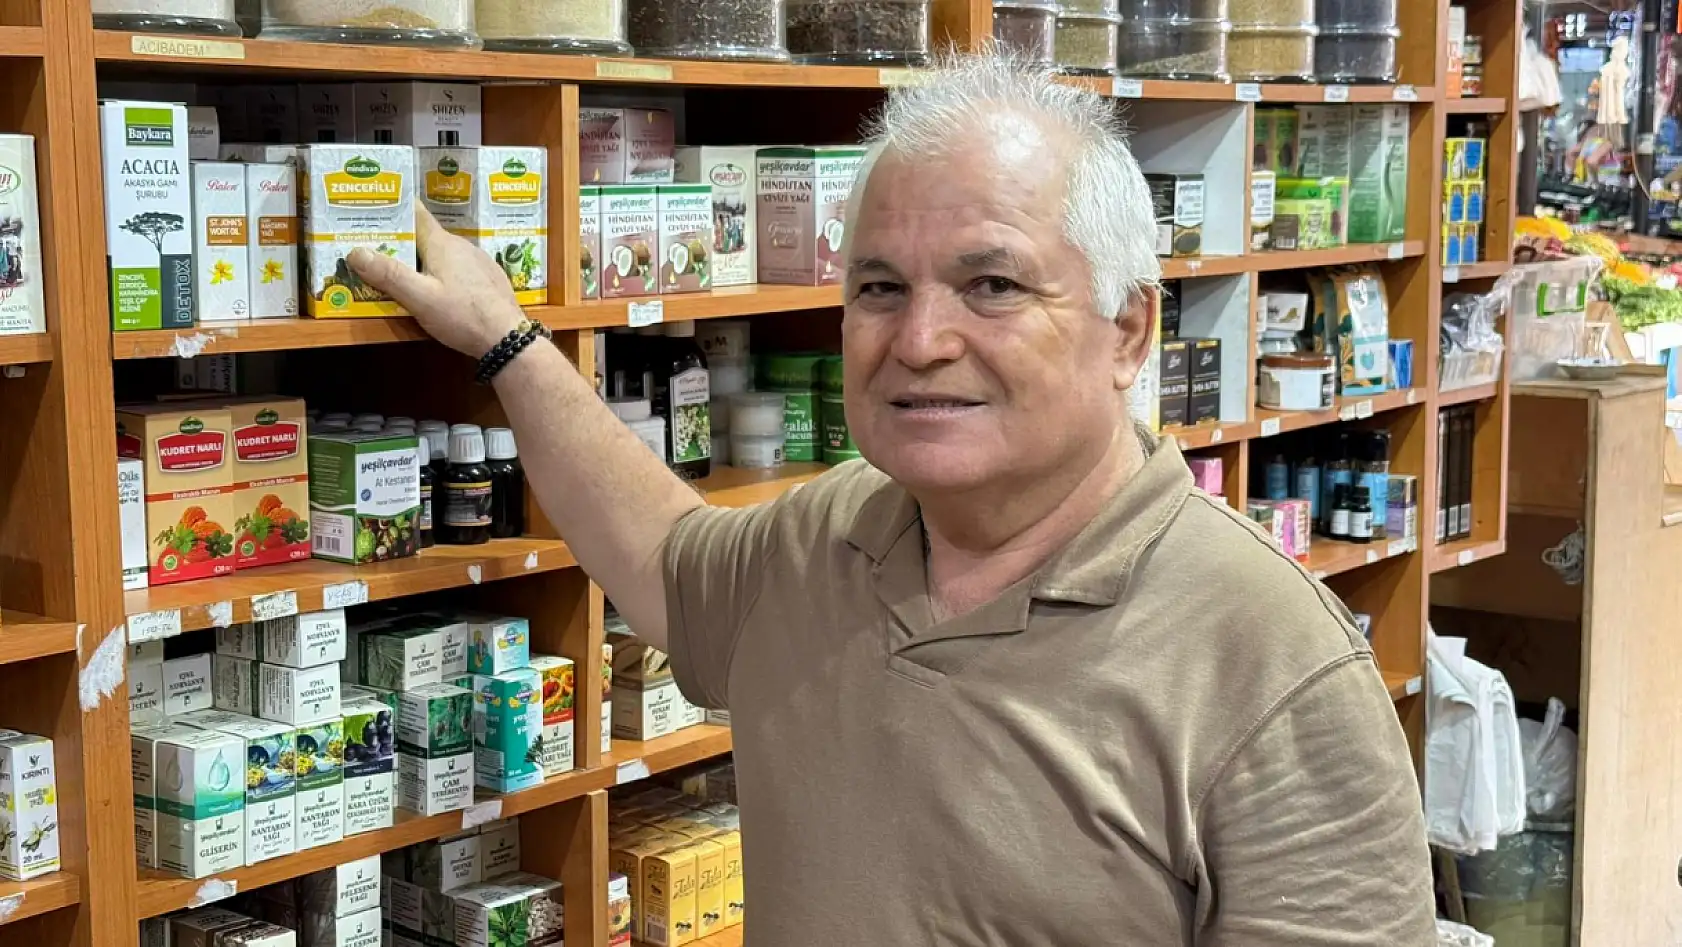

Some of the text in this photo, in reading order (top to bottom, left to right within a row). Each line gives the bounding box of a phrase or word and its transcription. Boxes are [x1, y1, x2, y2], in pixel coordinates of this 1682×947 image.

[431, 104, 465, 115] SHIZEN
[128, 127, 171, 142] Baykara
[121, 159, 180, 174] ACACIA
[331, 179, 397, 193] ZENCEFİLLİ
[175, 259, 192, 322] DETOX
[237, 434, 270, 447] KUDRET
[160, 444, 196, 457] KUDRET
[118, 470, 140, 482] Oils
[300, 808, 341, 823] KANTARON
[251, 821, 291, 837] KANTARON
[200, 840, 239, 858] GLİSERİN
